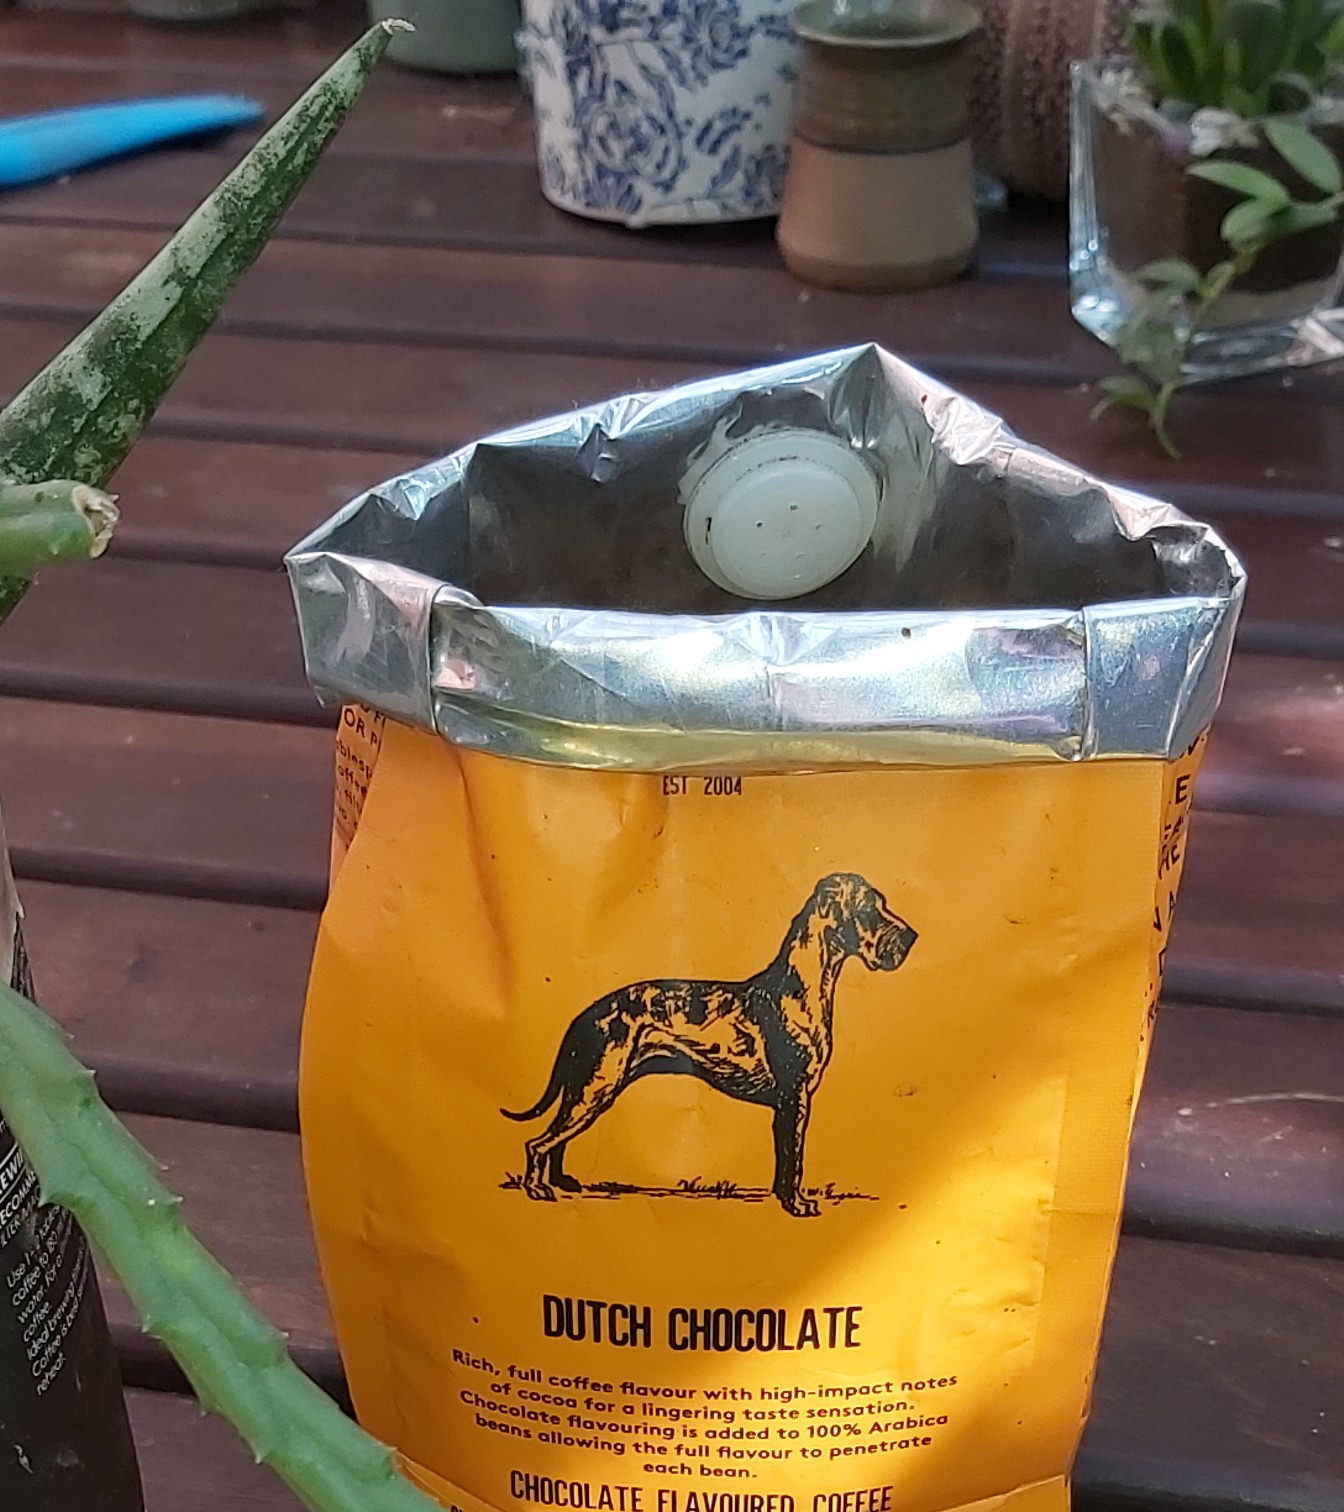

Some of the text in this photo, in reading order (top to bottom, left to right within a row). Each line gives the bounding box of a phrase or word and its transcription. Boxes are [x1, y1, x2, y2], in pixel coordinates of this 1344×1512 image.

[662, 775, 742, 796] EST 2004
[542, 1293, 863, 1352] DUTCH CHOCOLATE
[452, 1348, 959, 1403] Rich, full coffee flavour with high-impact notes
[459, 1389, 949, 1441] Chocolate flavouring is added to 100% Arabica
[490, 1382, 916, 1424] of cocoa for a lingering taste sensation.
[474, 1412, 934, 1461] beans allowing the full flavour to penetrate
[642, 1462, 758, 1479] each bean.
